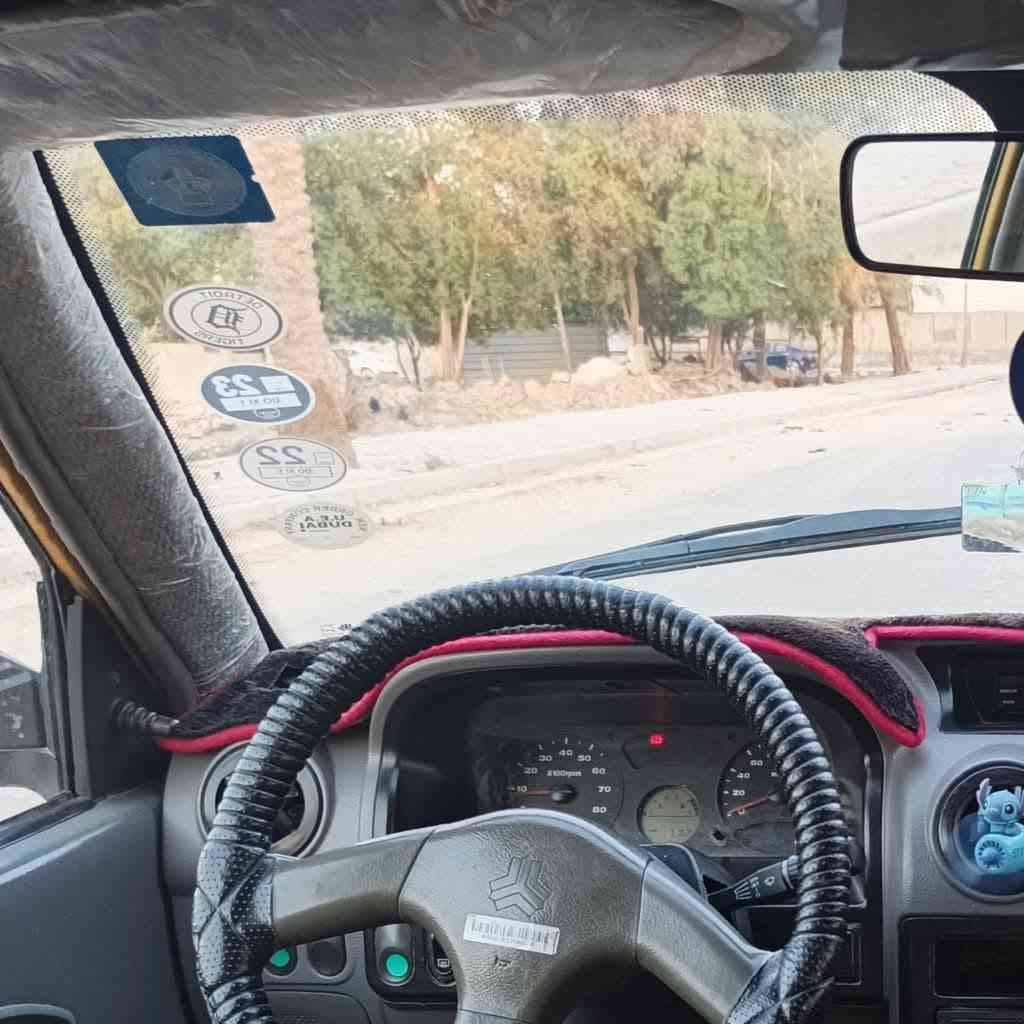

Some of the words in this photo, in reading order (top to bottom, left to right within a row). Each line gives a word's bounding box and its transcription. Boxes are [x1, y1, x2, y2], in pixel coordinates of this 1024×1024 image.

[559, 748, 573, 756] 40
[538, 754, 552, 762] 30
[577, 754, 592, 762] 50
[524, 767, 538, 775] 20
[592, 767, 606, 775] 60
[737, 772, 750, 780] 40
[517, 785, 528, 793] 10
[598, 785, 612, 793] 70
[732, 789, 745, 797] 20
[592, 806, 607, 814] 80
